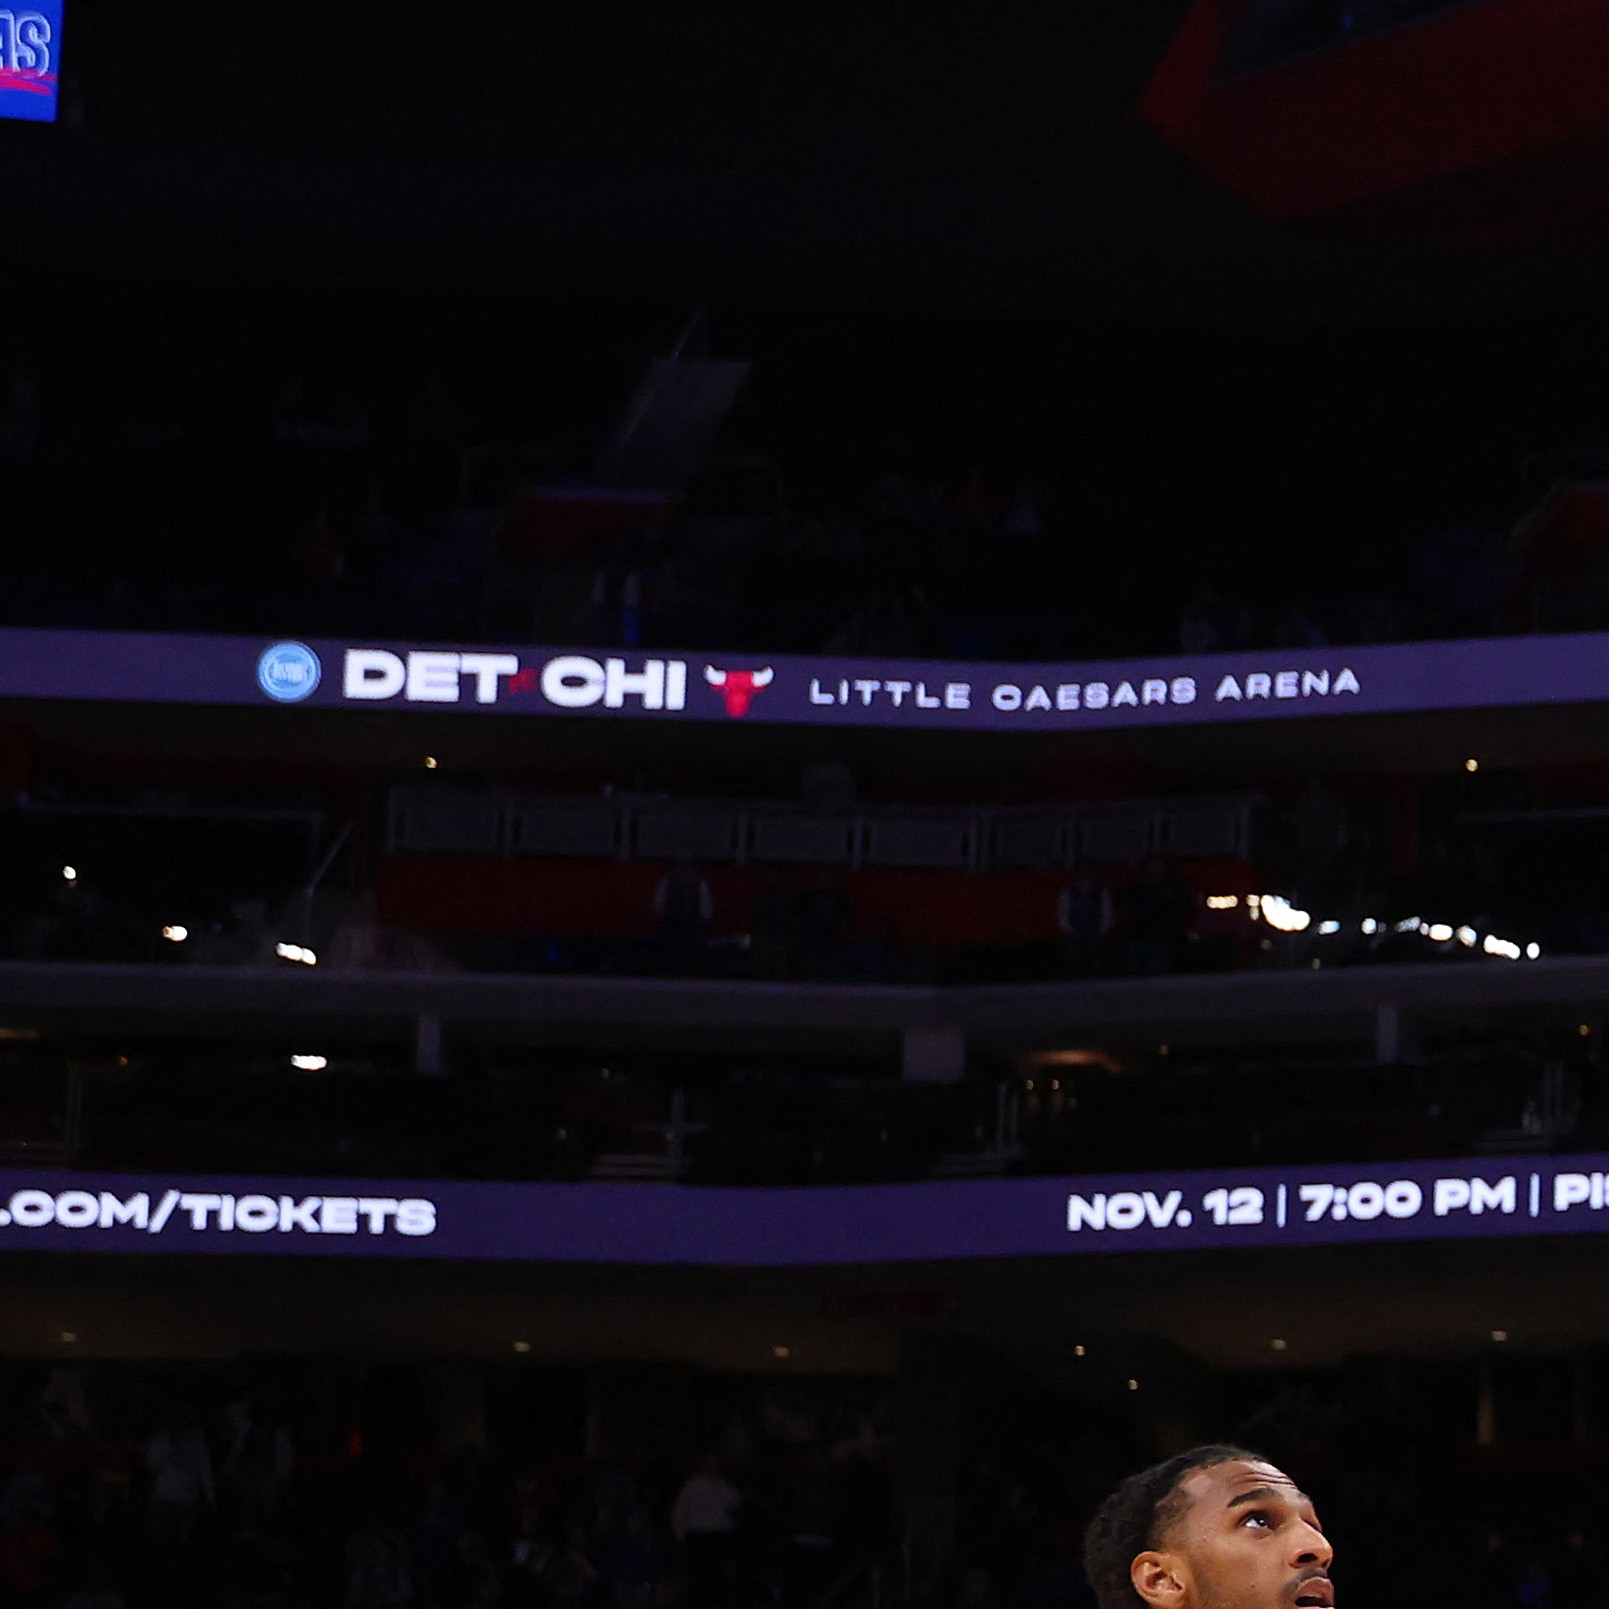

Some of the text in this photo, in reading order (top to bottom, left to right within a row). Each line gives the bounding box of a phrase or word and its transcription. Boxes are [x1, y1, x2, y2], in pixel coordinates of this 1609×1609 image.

[343, 648, 518, 703] DET
[541, 656, 687, 710] CHI
[811, 668, 1360, 711] LITTLE CAESARS ARENA
[1067, 1191, 1192, 1231] NOV.
[1203, 1187, 1264, 1225] 12
[1300, 1180, 1422, 1221] 7:00
[1433, 1177, 1516, 1216] PM
